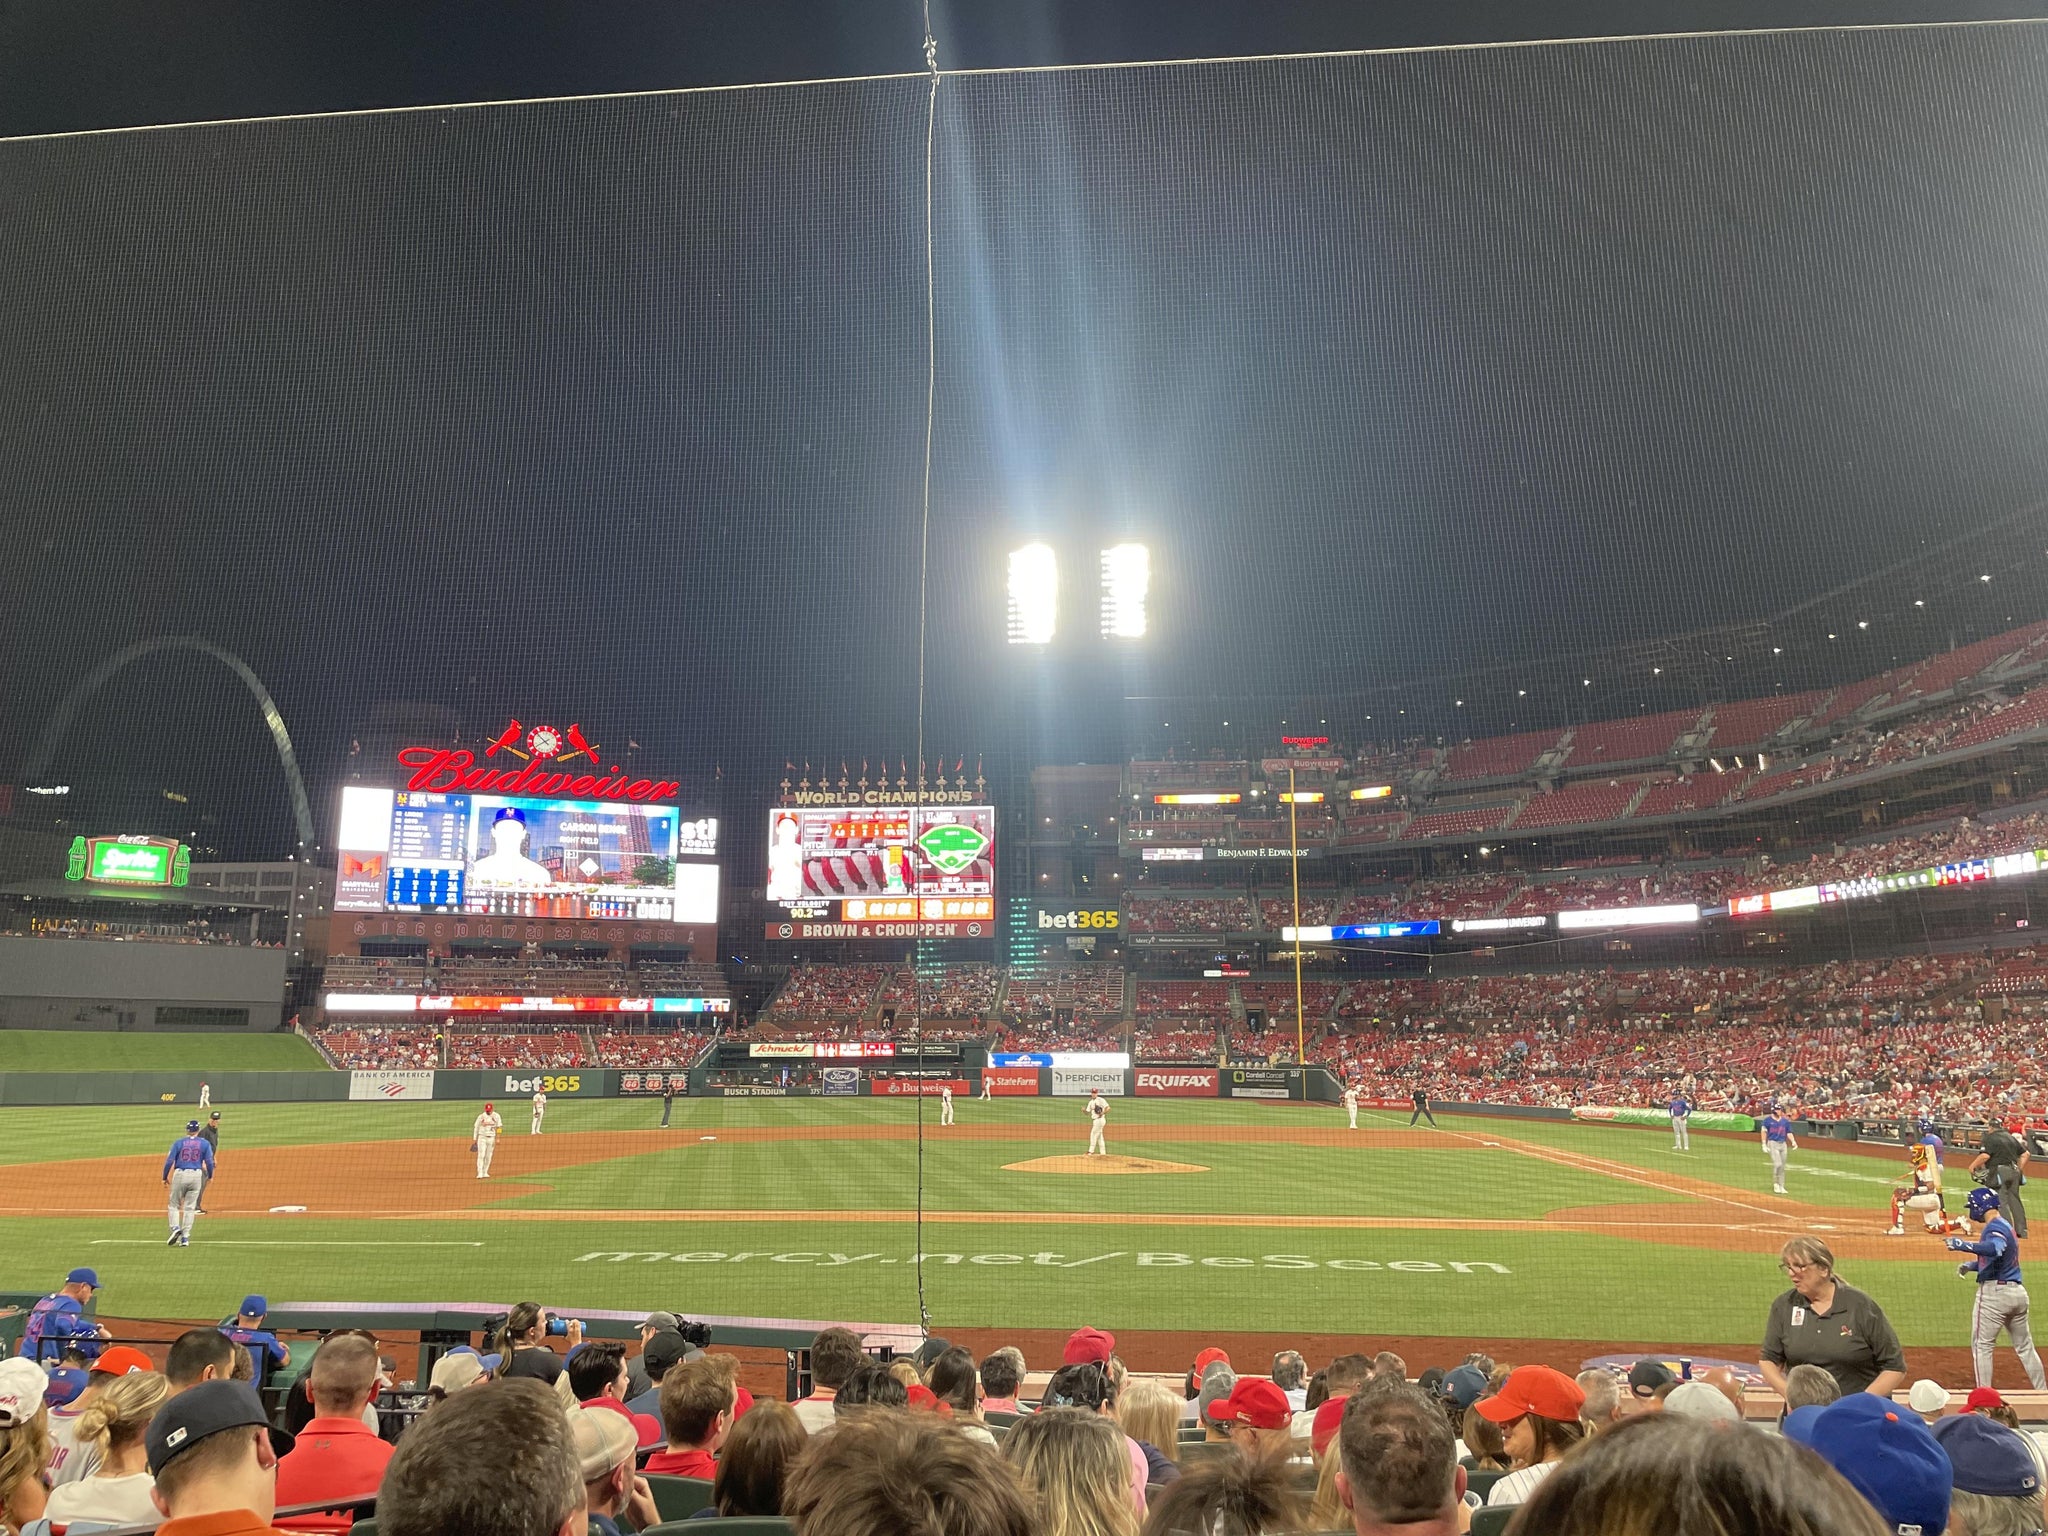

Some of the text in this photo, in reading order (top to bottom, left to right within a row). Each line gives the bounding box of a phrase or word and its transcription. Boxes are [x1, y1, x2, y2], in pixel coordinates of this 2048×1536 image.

[1282, 736, 1328, 744] BUDWEISER
[397, 747, 680, 801] Budweiser
[795, 789, 973, 805] WORLD CHAMPIONS
[559, 822, 596, 833] CARSON
[681, 818, 716, 841] stl
[560, 836, 599, 845] RIGHT FIELD
[1217, 849, 1258, 858] BENJAMIN
[1259, 849, 1267, 857] F.
[791, 908, 814, 919] 90.2
[1038, 910, 1119, 929] bet365
[1509, 916, 1546, 927] UNIVERSITY
[382, 922, 388, 935] 1
[396, 922, 407, 935] 2
[415, 923, 425, 936] 6
[453, 923, 468, 937] 10
[477, 924, 493, 938] 14
[501, 925, 517, 938] 17
[525, 925, 543, 940] 20
[554, 926, 573, 940] 23
[580, 926, 599, 941] 24
[607, 927, 625, 942] 42
[633, 928, 652, 942] 45
[657, 928, 675, 942] 85
[803, 925, 857, 937] BROWN
[861, 926, 871, 936] &
[875, 924, 955, 937] CROUPPEN
[1135, 937, 1151, 945] Mercy
[754, 1044, 809, 1053] Schnucks
[902, 1046, 919, 1054] Mercy
[830, 1071, 852, 1081] Ford
[1066, 1074, 1122, 1082] PERFICIENT
[505, 1075, 580, 1093] bet365
[1137, 1074, 1212, 1090] EQUIFAX
[724, 1088, 786, 1096] BUSCH STADIUM
[572, 1251, 1513, 1274] mercy.net/BeSeen
